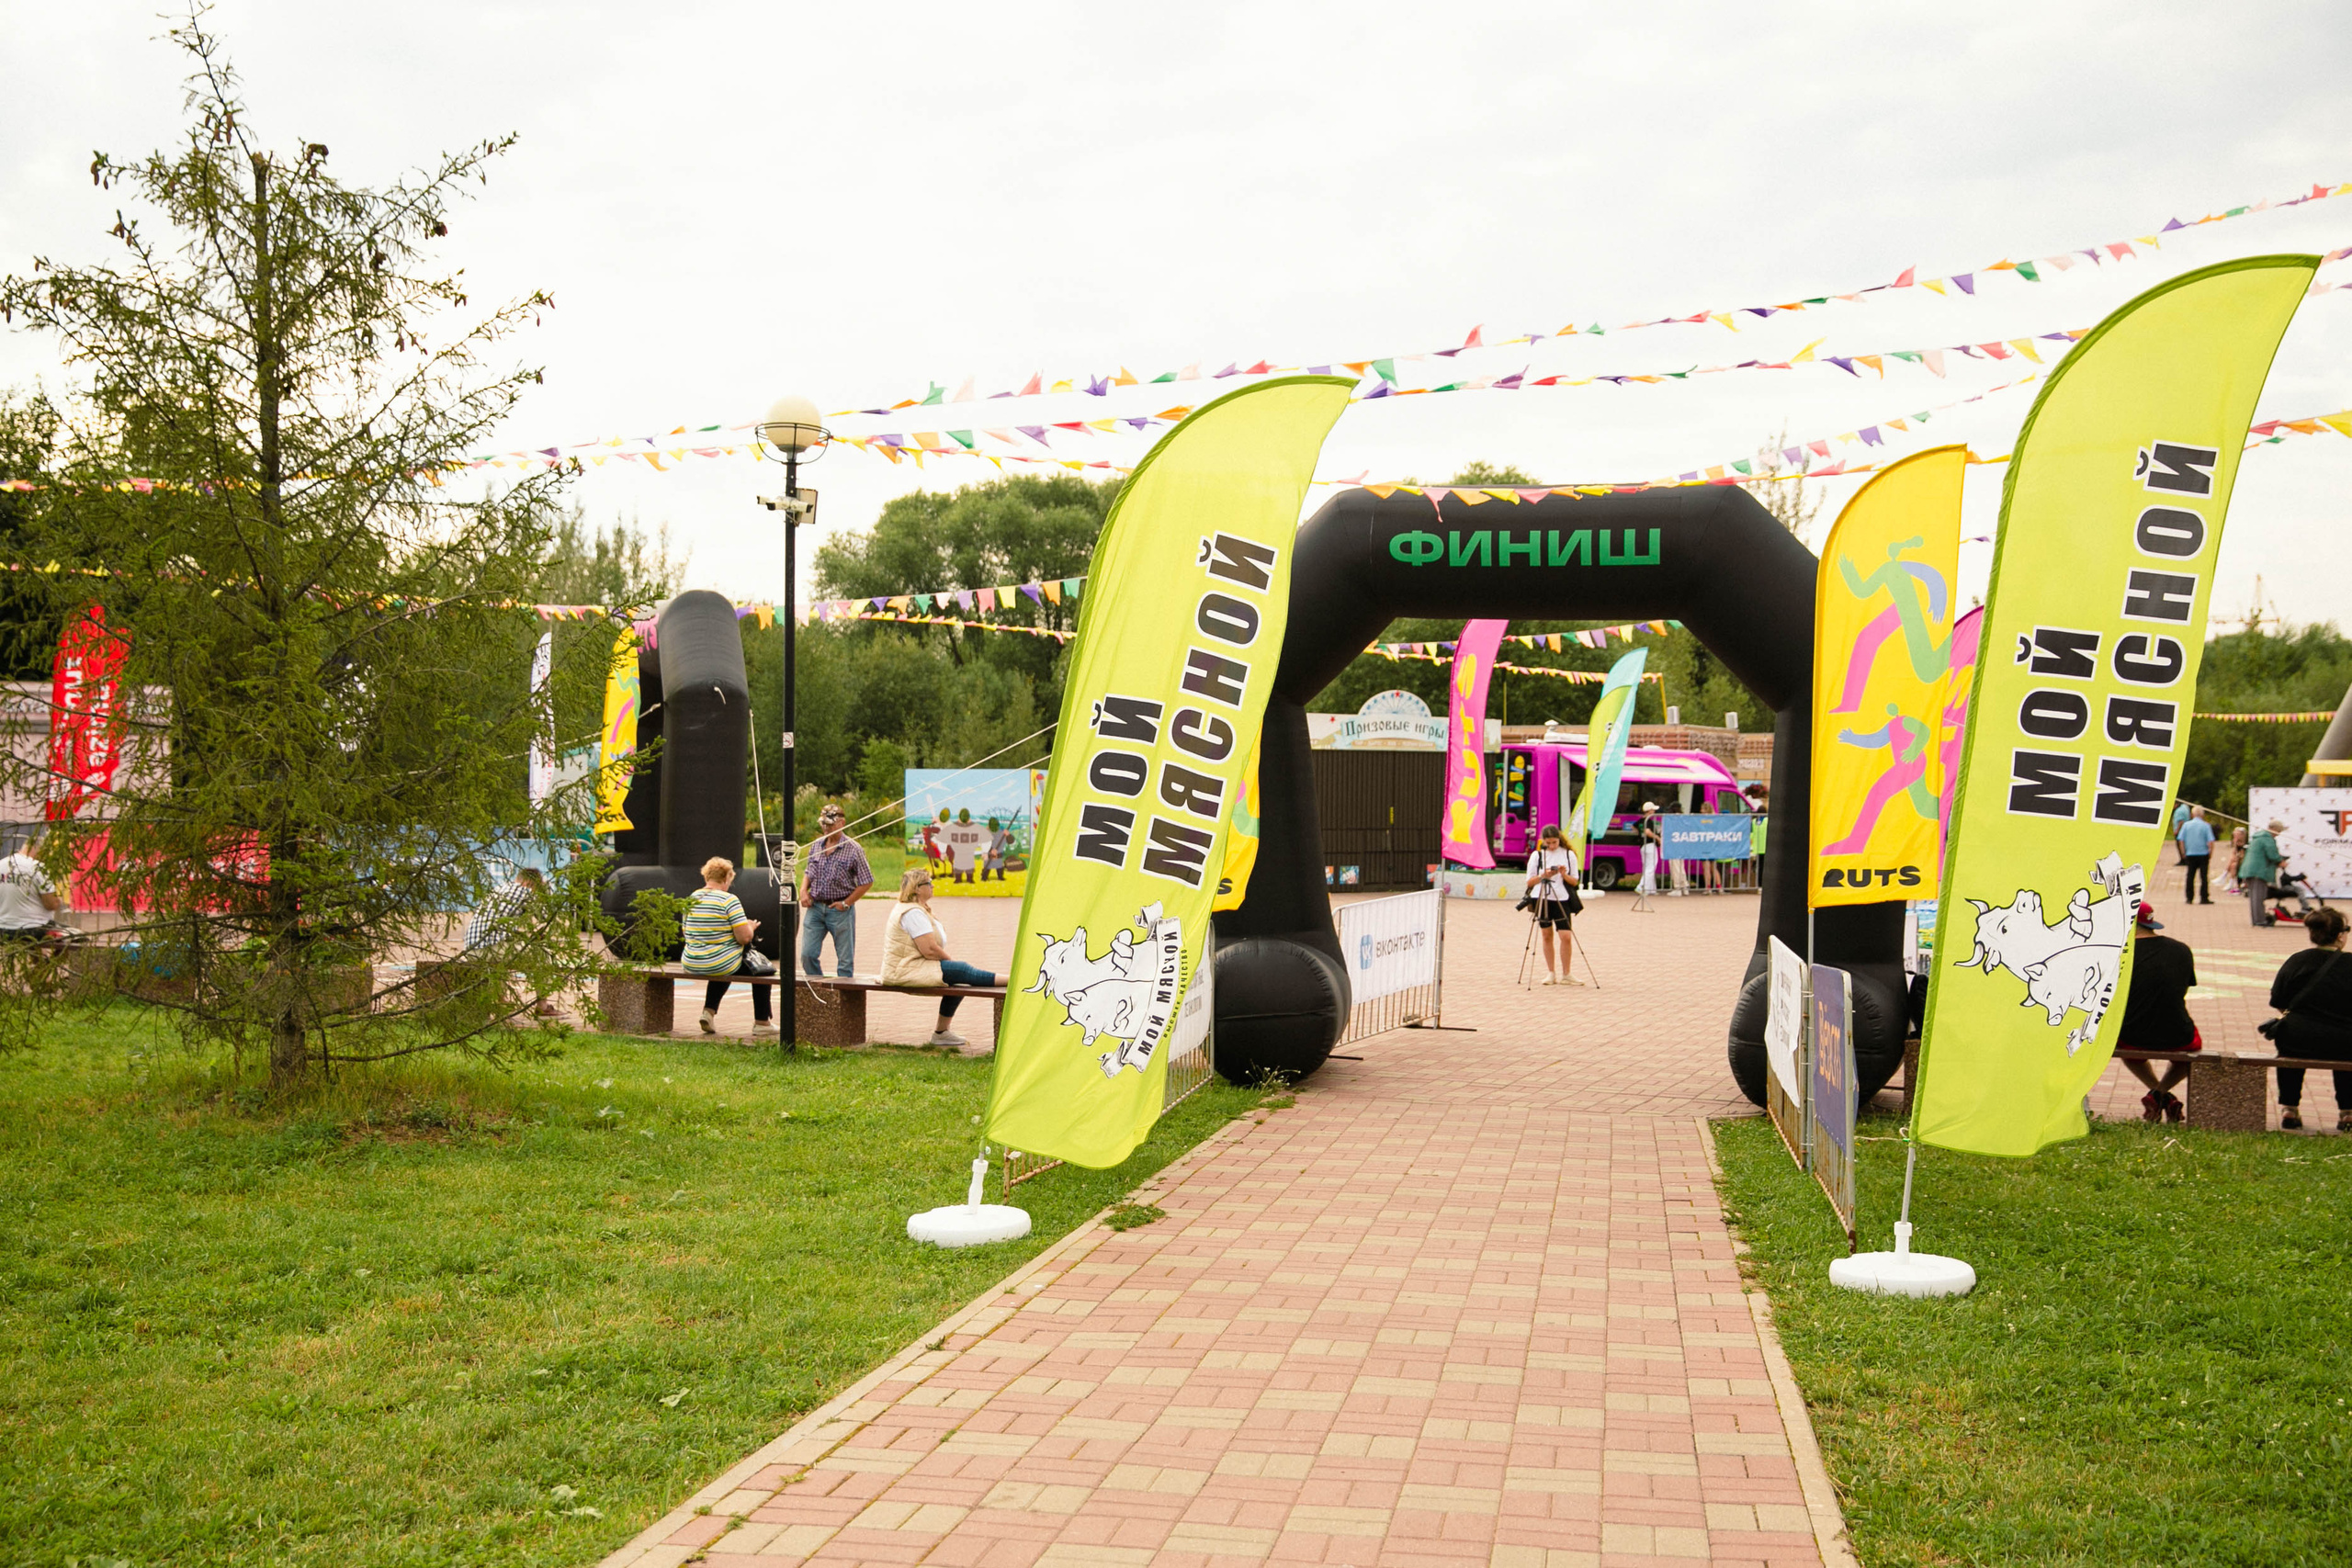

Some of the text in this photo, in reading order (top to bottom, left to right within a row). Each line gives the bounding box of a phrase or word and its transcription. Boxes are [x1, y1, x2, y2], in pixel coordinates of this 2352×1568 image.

[1389, 528, 1661, 567] ФИНИШ
[2094, 442, 2218, 826] МЯСНОЙ
[1142, 533, 1276, 888] МЯСНОЙ
[1346, 720, 1444, 739] Призовые игры
[2008, 627, 2100, 818] МОЙ
[1075, 695, 1164, 868] МОЙ
[1671, 831, 1743, 842] ЗАВТРАКИ
[1822, 865, 1921, 887] RUTS
[1137, 1014, 1165, 1055] МОЙ
